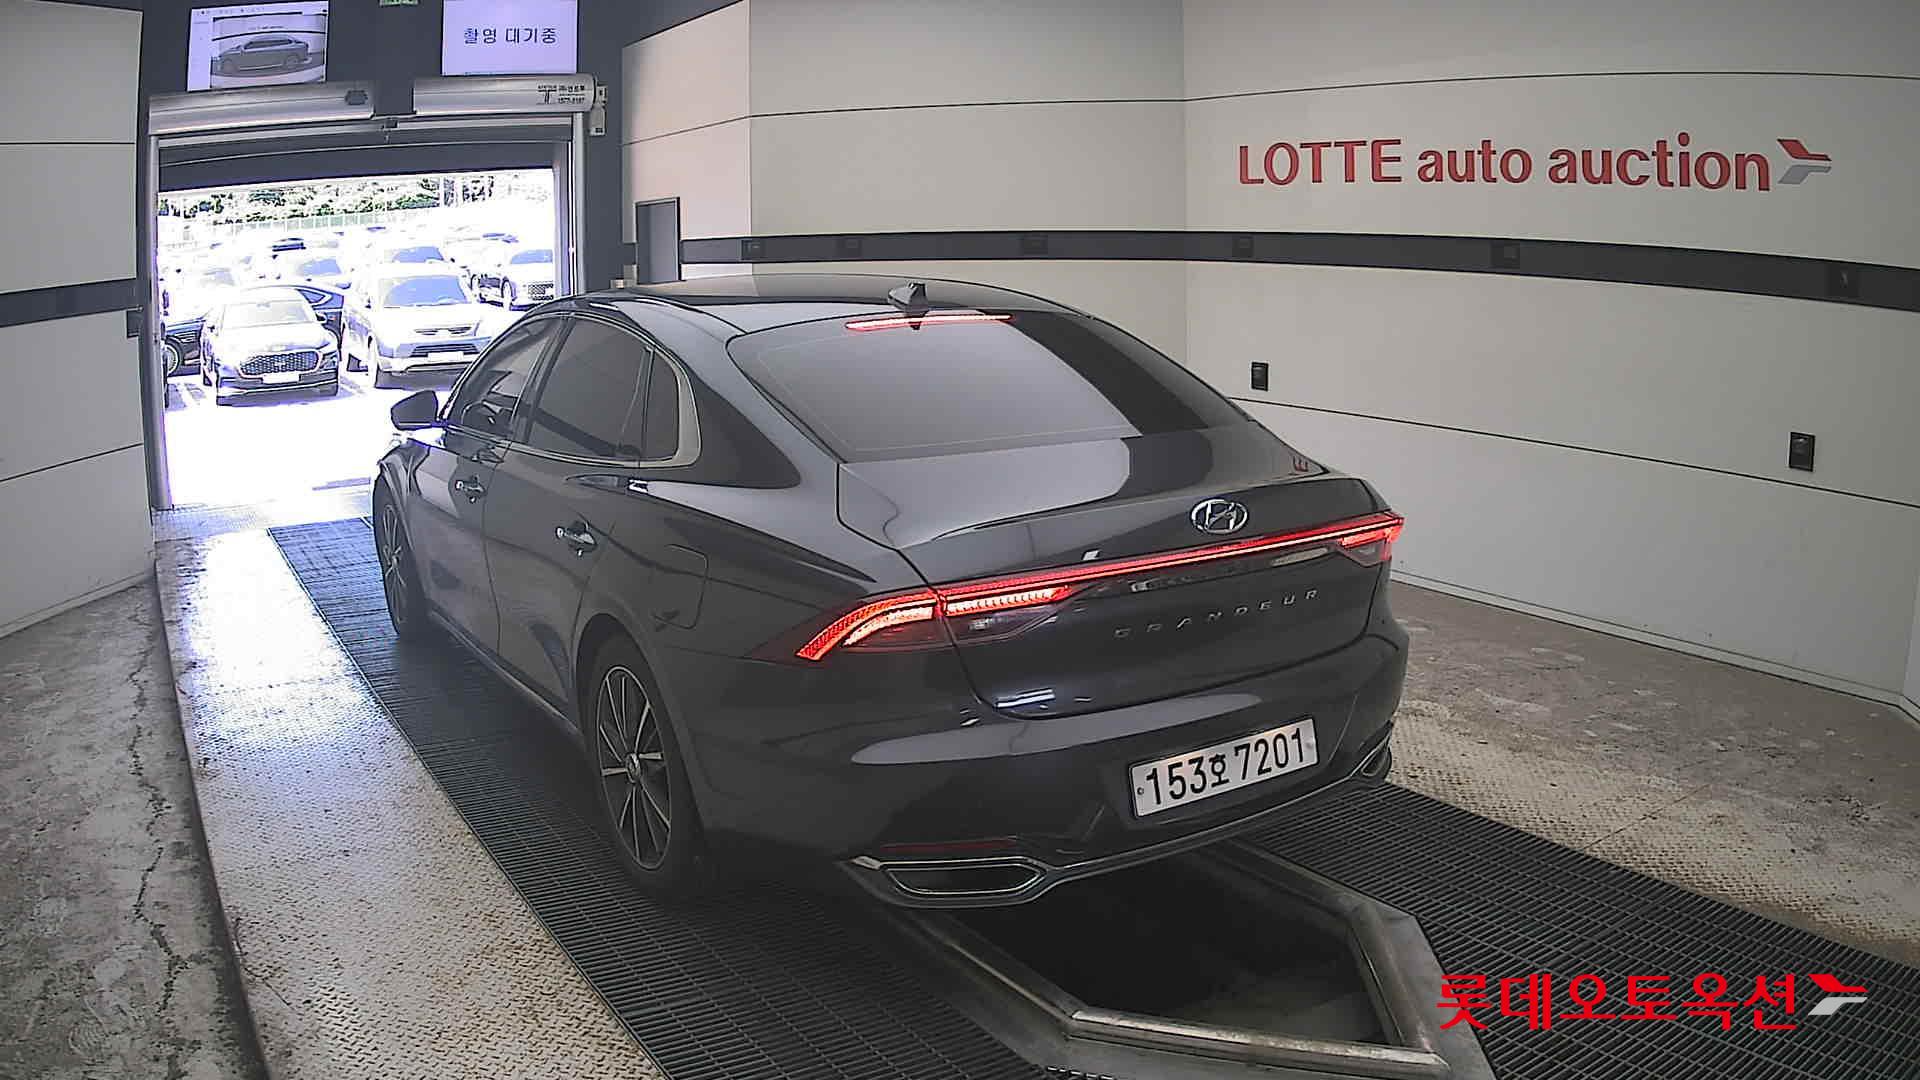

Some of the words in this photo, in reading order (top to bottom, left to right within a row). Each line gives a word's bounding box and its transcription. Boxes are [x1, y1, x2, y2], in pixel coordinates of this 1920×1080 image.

[464, 28, 497, 44] 촬영
[505, 27, 557, 44] 대기중
[1239, 138, 1402, 186] LOTTE
[1418, 139, 1533, 184] auto
[1548, 132, 1771, 192] auction
[1113, 588, 1319, 638] GRANDEUR
